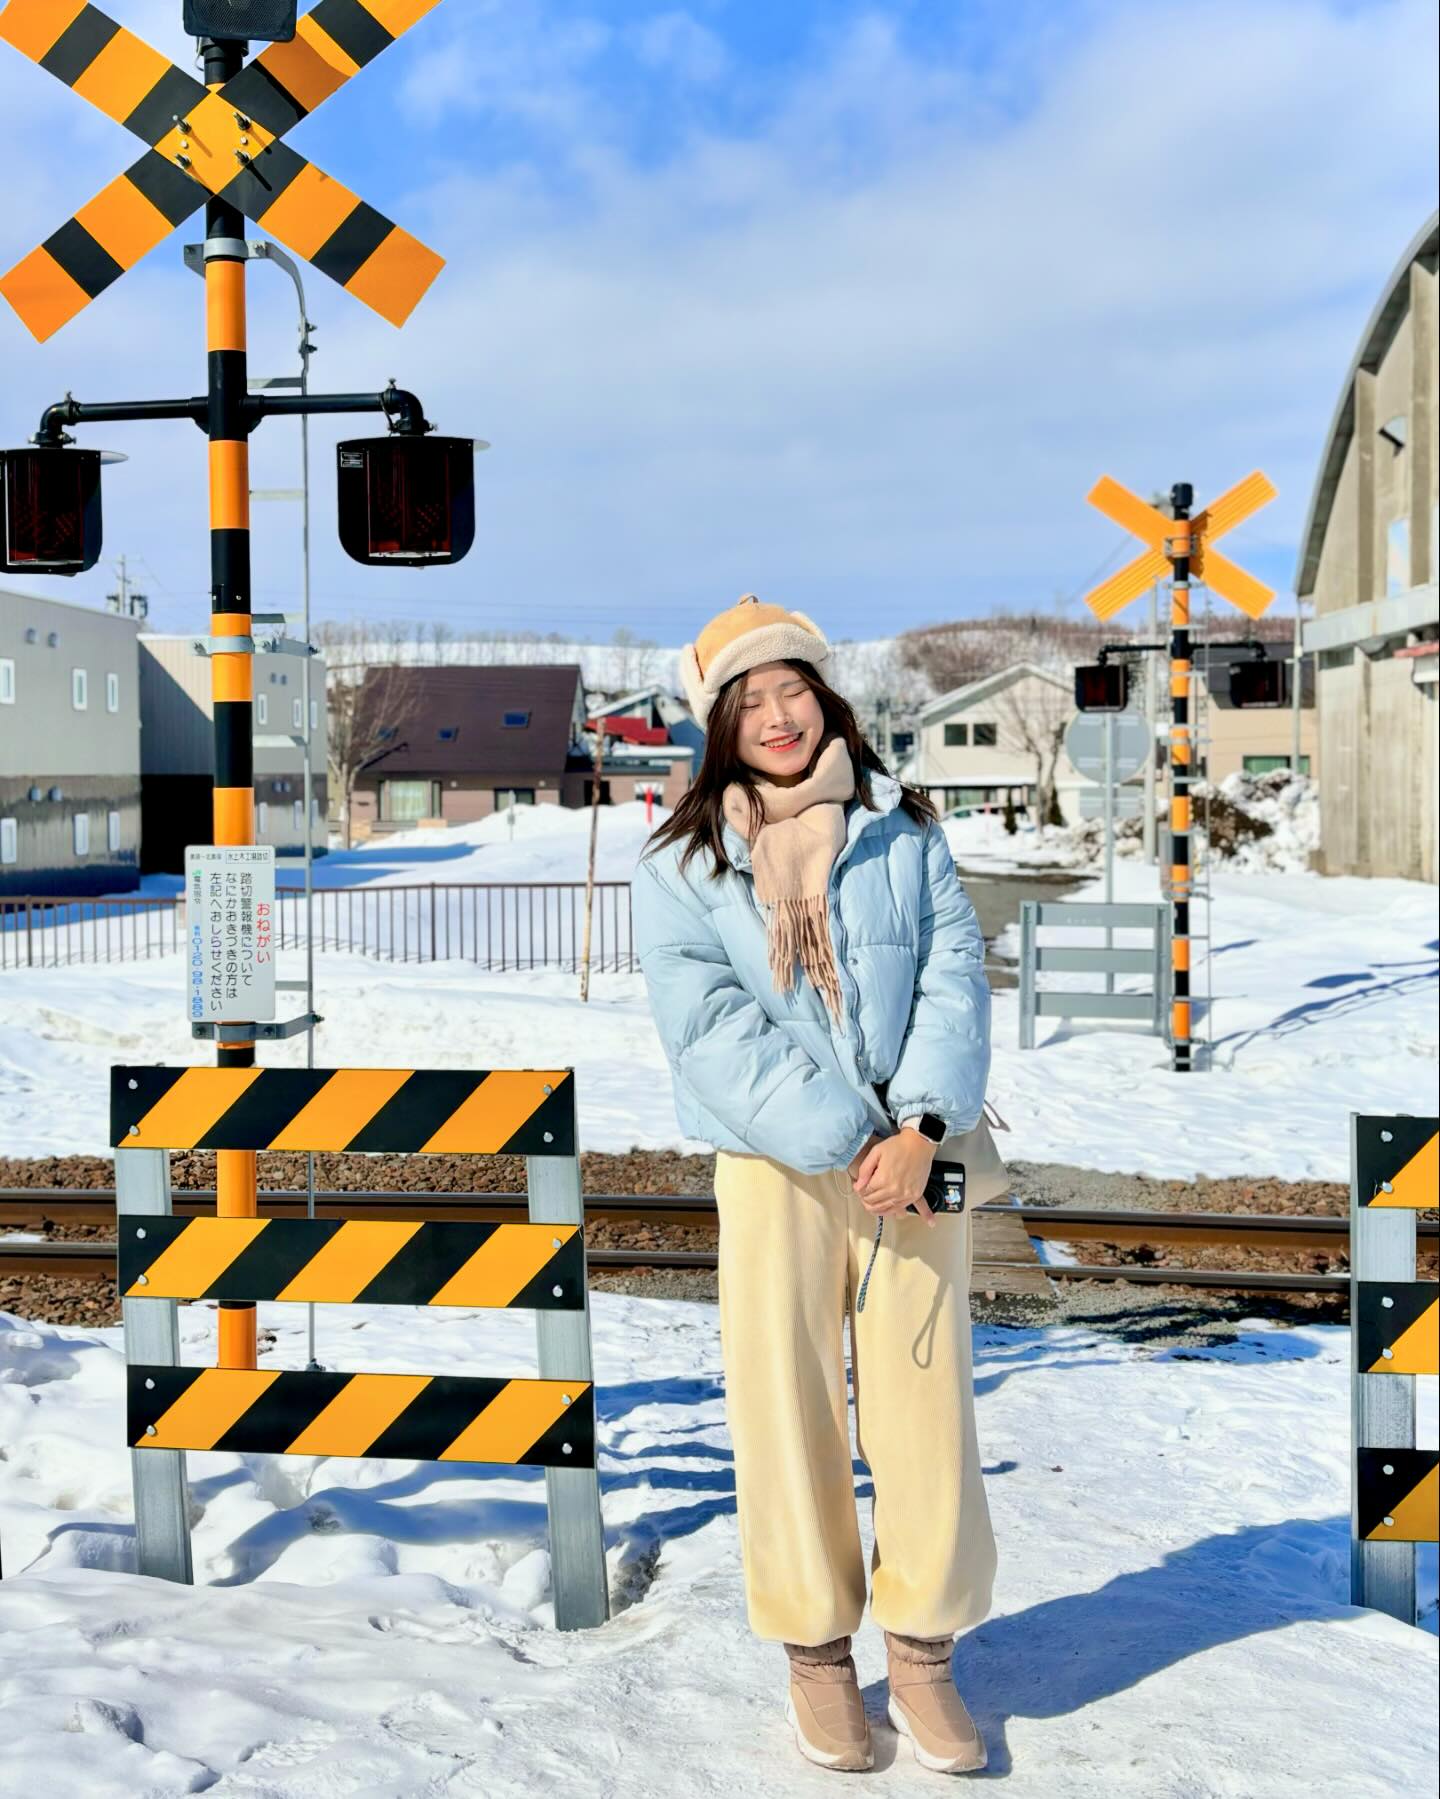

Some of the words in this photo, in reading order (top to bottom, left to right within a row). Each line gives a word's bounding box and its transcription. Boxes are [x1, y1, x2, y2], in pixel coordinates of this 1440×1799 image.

[209, 871, 222, 1011] 左記へおしらせください
[225, 871, 238, 998] なにかおきづきの方は
[240, 871, 253, 986] 踏切警報機について
[257, 902, 271, 963] おねがい
